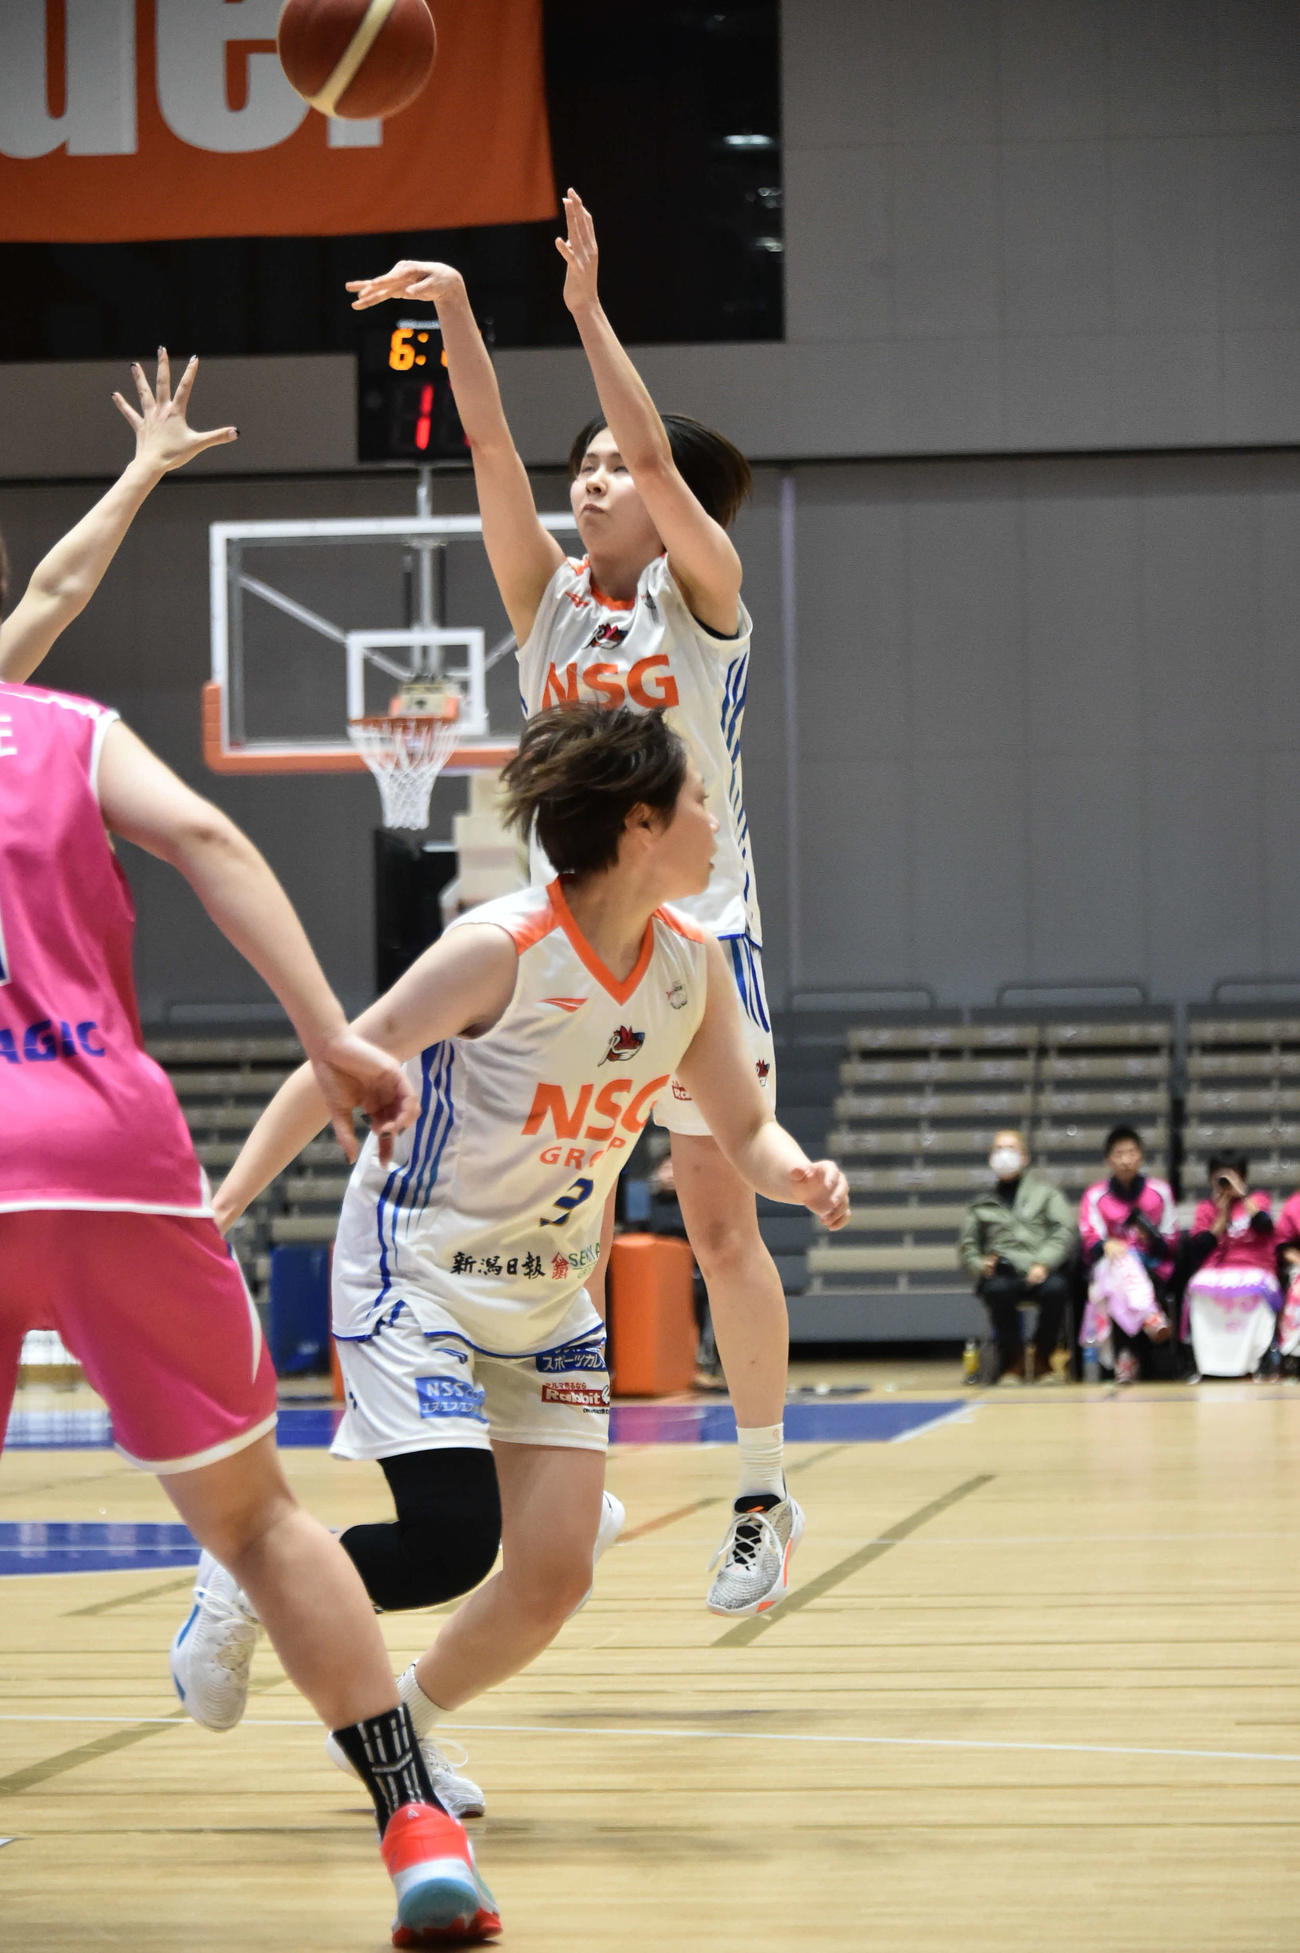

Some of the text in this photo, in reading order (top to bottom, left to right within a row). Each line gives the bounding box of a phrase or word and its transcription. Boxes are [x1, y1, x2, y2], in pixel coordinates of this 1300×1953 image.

[541, 653, 680, 711] NSG
[450, 1251, 546, 1279] 新潟日報
[545, 1387, 601, 1405] Rabbit
